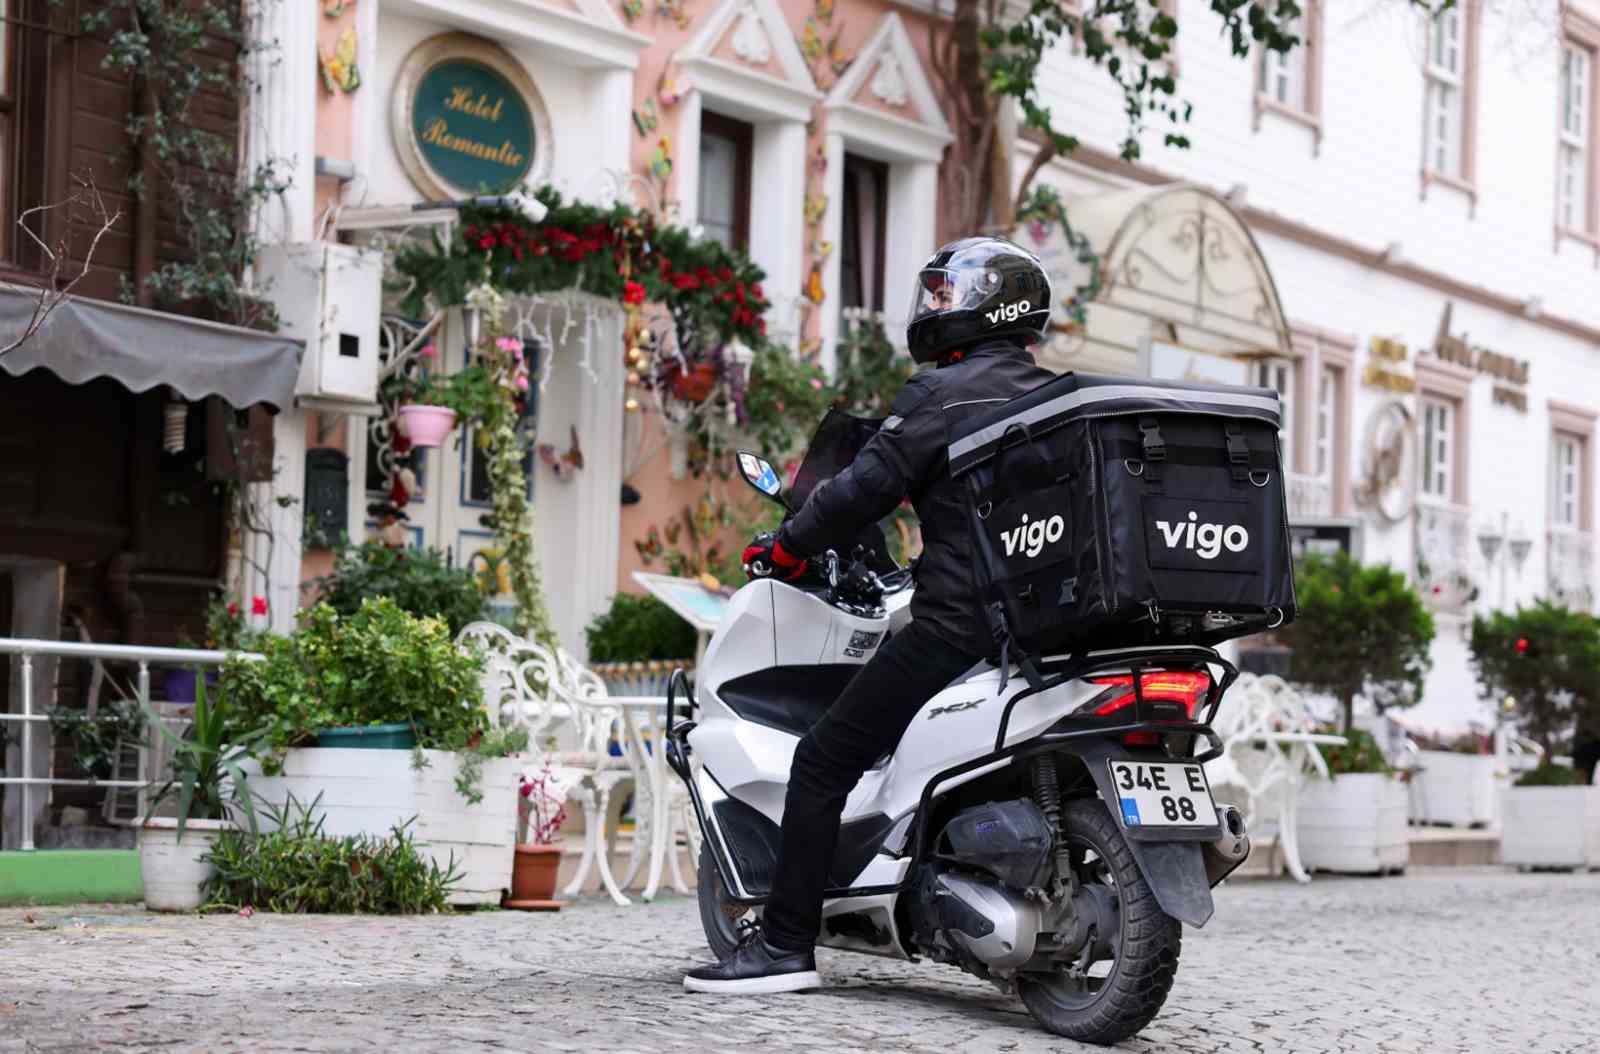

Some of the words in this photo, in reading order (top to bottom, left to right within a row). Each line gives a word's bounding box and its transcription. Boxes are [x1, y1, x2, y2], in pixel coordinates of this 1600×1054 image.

[445, 86, 504, 122] Hotel
[423, 117, 523, 167] Romantic
[985, 300, 1031, 324] vigo
[1000, 513, 1064, 558] vigo
[1156, 511, 1249, 559] vigo
[1161, 795, 1197, 822] 88
